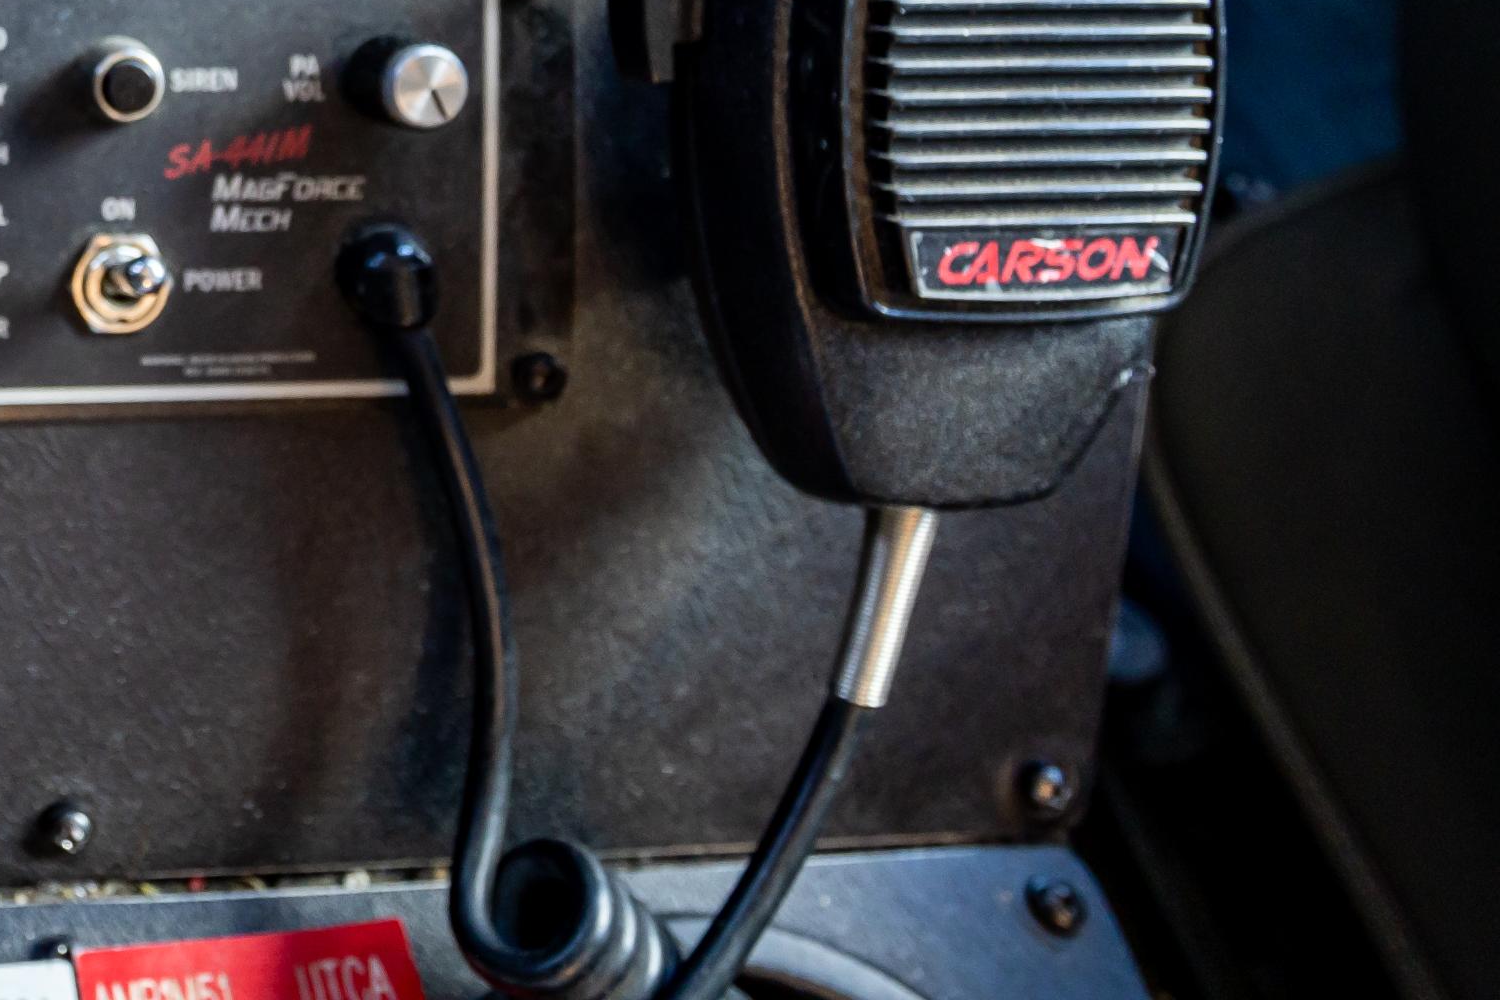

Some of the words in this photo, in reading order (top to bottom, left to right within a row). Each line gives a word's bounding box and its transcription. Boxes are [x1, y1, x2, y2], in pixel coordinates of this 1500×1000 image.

[169, 67, 238, 93] SIREN
[936, 235, 1161, 286] CARSON
[184, 267, 264, 292] POWER
